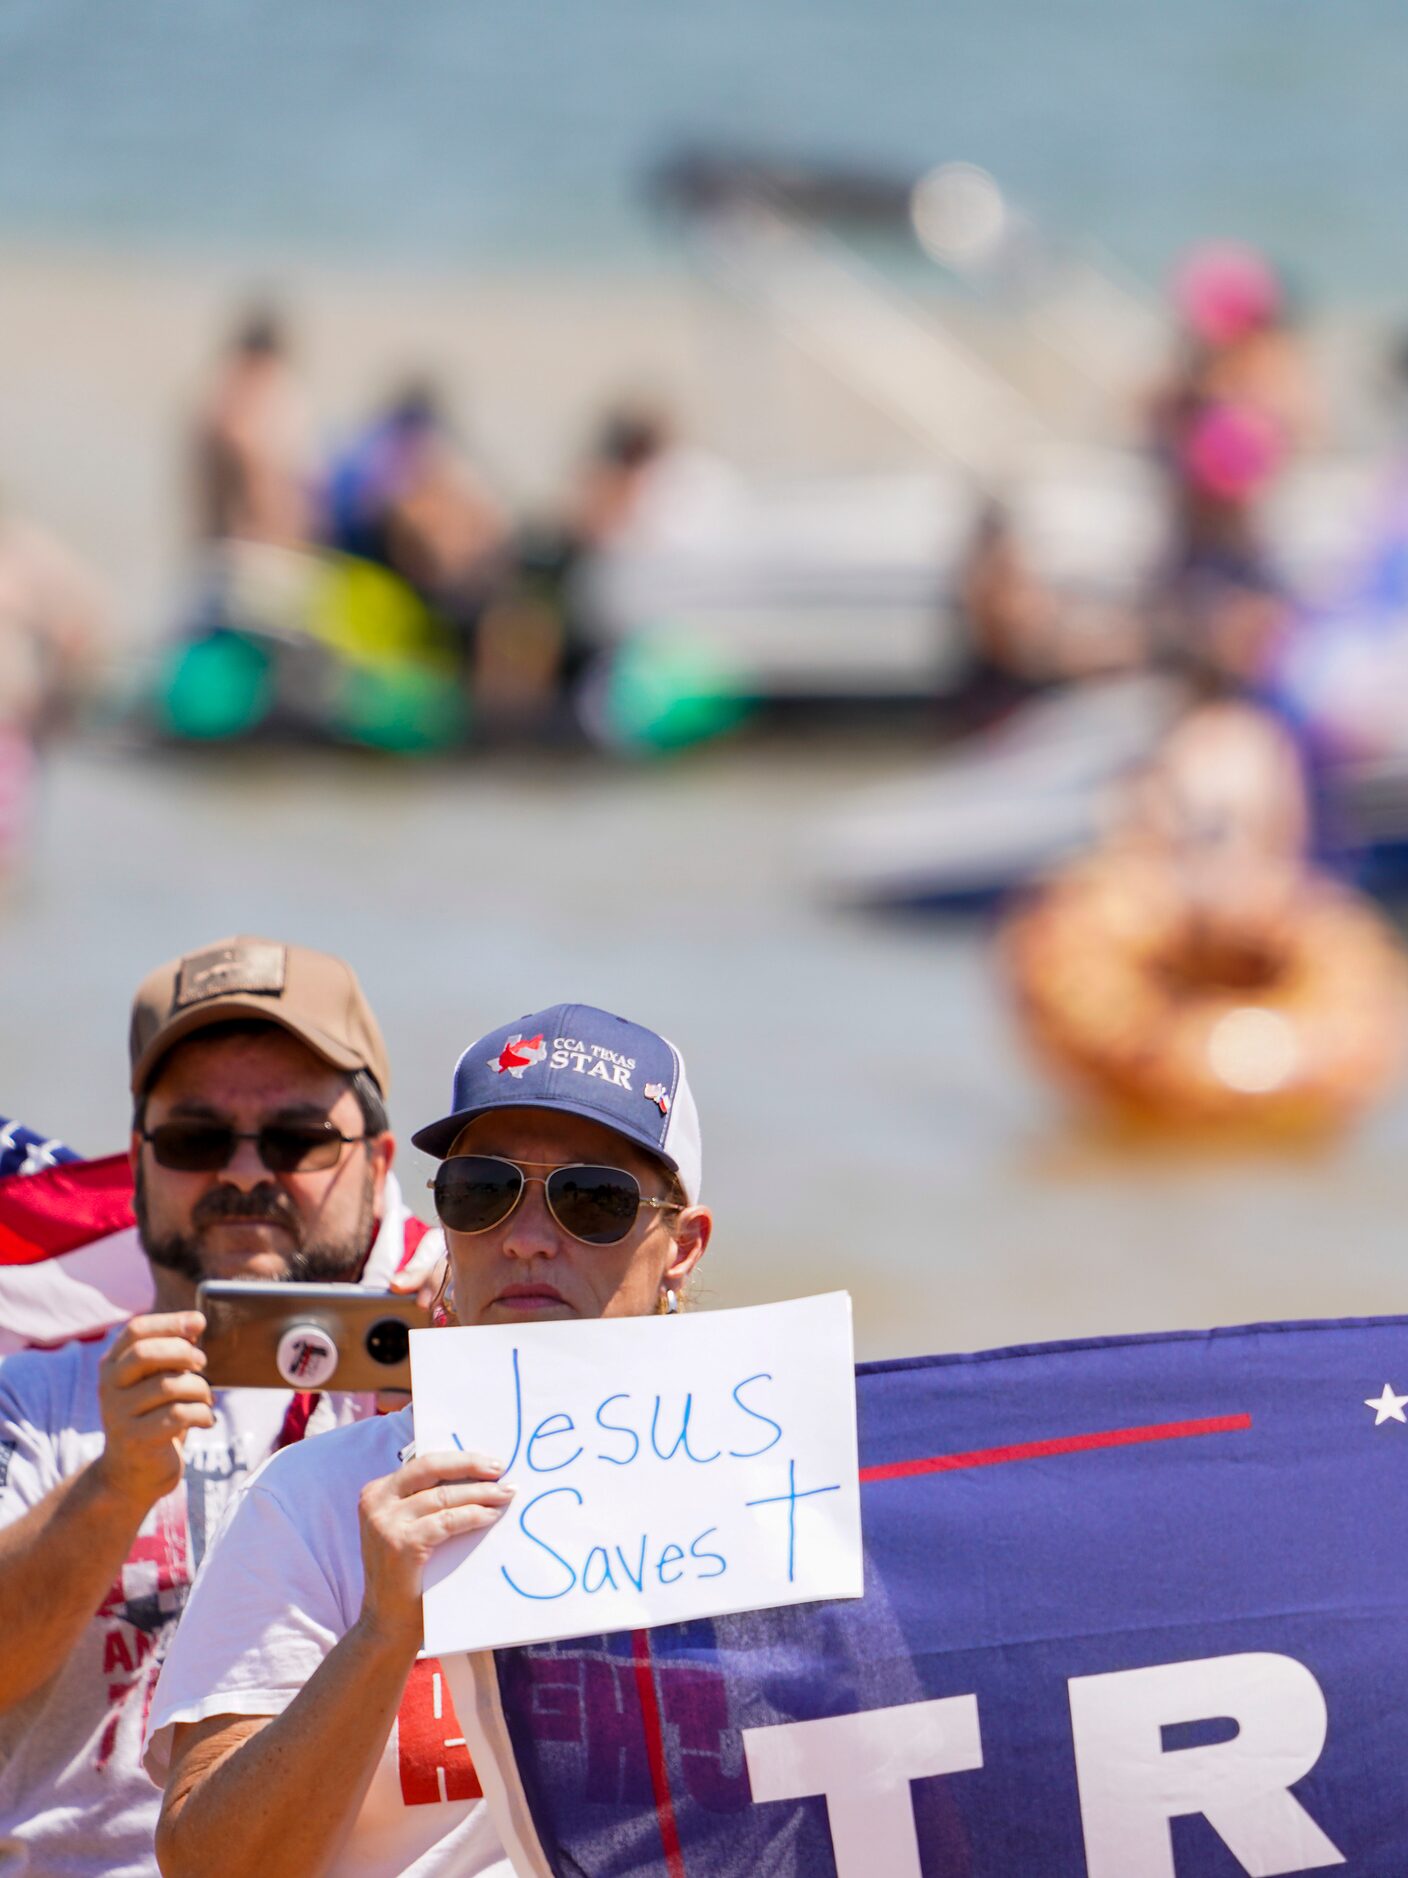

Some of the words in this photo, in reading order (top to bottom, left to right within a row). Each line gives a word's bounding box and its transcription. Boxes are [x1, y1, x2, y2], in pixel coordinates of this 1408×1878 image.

[549, 1050, 633, 1091] STAR
[553, 1037, 585, 1053] CCA
[590, 1044, 637, 1071] TEXAS
[452, 1347, 782, 1483] Jesus
[501, 1486, 727, 1601] Saves
